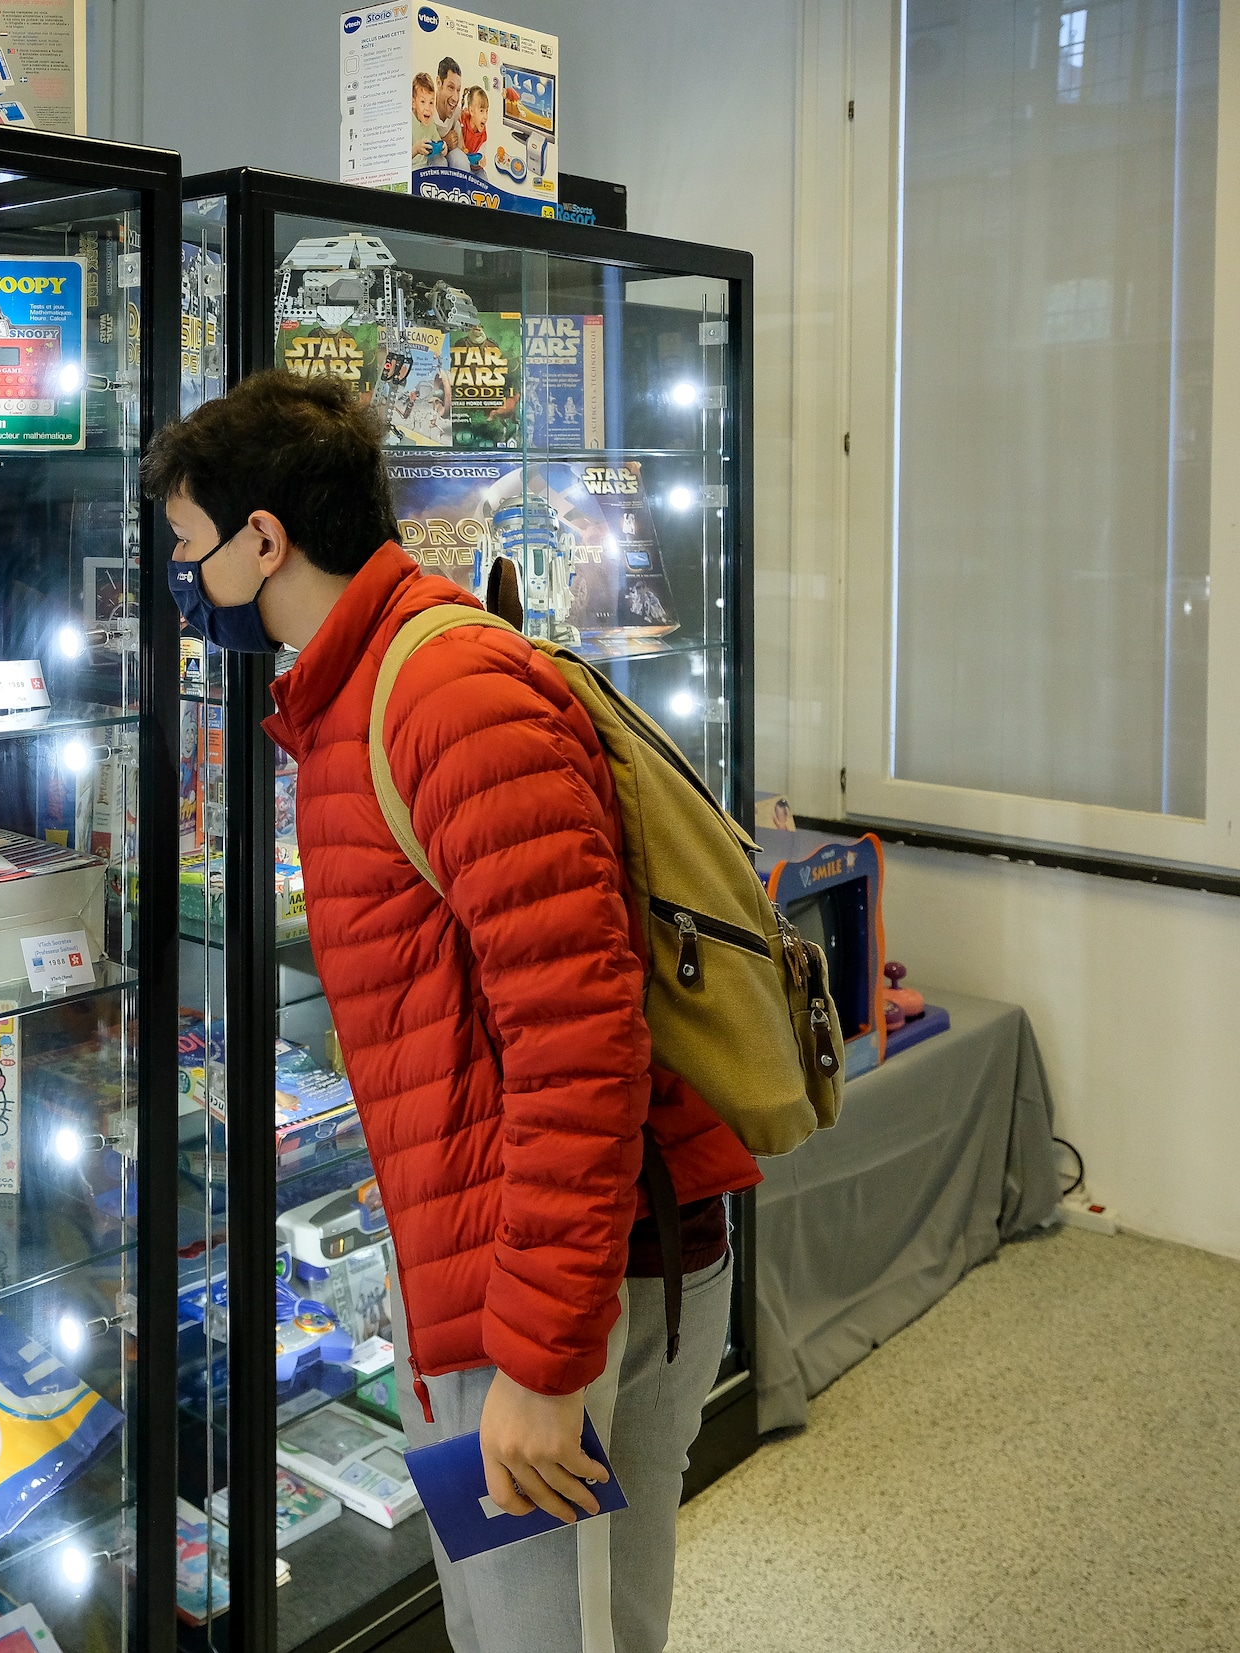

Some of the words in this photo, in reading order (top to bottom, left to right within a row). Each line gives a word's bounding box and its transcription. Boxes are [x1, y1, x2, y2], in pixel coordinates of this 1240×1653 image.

[366, 9, 392, 23] Storio
[393, 4, 408, 17] TV
[418, 13, 438, 26] vtech
[344, 20, 361, 29] vtech
[361, 36, 377, 44] INCLUS
[479, 51, 487, 67] A
[490, 51, 497, 65] B
[483, 75, 488, 91] 1
[493, 77, 499, 90] 2
[419, 169, 440, 178] SYSTÈME
[440, 169, 467, 181] MULTIMÉDIA
[467, 174, 490, 191] ÉDUCATIF
[420, 182, 471, 205] Storio
[472, 190, 500, 210] TV
[557, 203, 597, 226] Resort
[572, 203, 594, 215] Sports
[88, 278, 99, 307] SIDE
[9, 329, 60, 339] SNOOPY
[525, 318, 581, 337] TAR
[400, 330, 439, 346] ECANOS
[285, 337, 364, 358] STAR
[450, 346, 508, 366] TAR
[285, 358, 364, 380] WARS
[23, 431, 73, 441] mathématique
[388, 466, 500, 479] MINDSTORMS
[581, 466, 638, 481] STAR
[583, 479, 639, 495] WARS
[812, 858, 842, 882] SMILE
